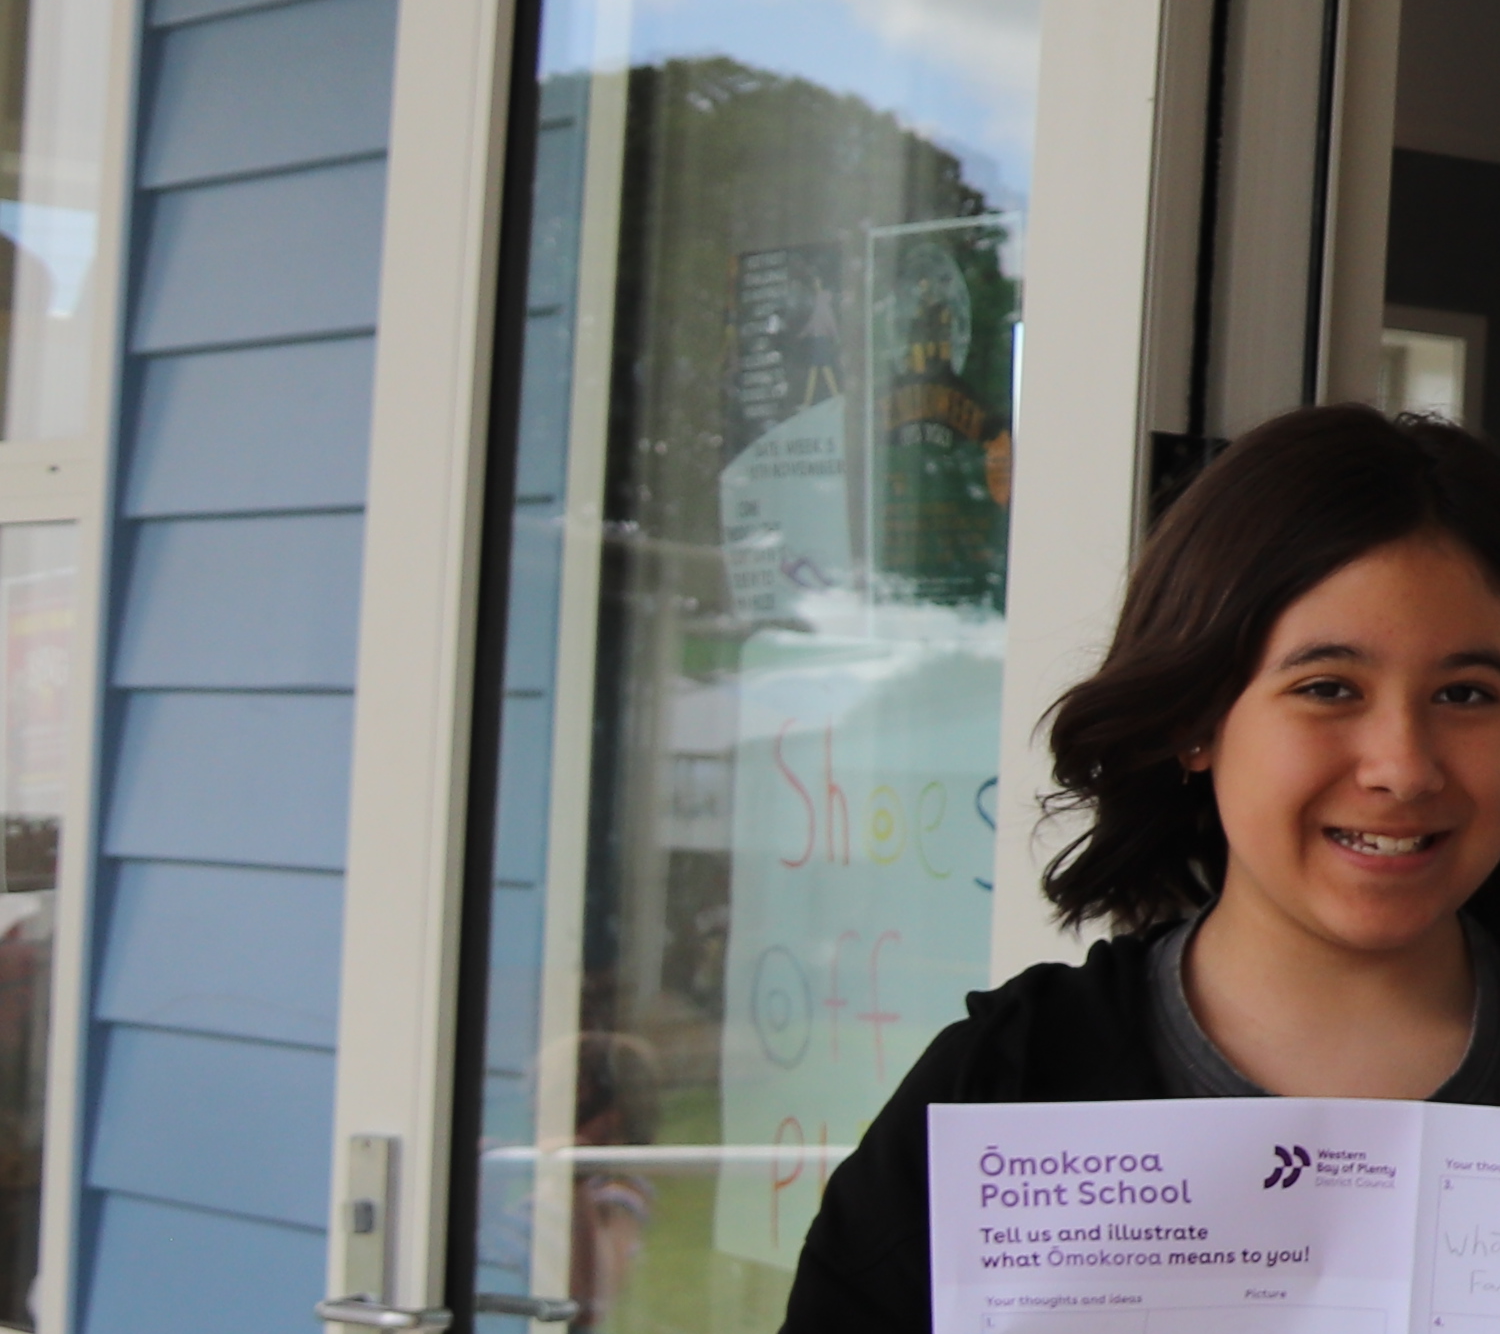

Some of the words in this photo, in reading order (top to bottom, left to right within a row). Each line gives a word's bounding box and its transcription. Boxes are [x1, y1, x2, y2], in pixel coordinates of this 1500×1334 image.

[980, 1145, 1162, 1176] Ōmokoroa
[1317, 1147, 1365, 1161] Western
[1316, 1161, 1338, 1175] Bay
[1342, 1163, 1354, 1174] of
[1358, 1164, 1396, 1177] Plenty
[1445, 1159, 1473, 1171] Your
[1315, 1176, 1352, 1188] District
[980, 1183, 1069, 1208] Point
[1078, 1178, 1191, 1205] School
[980, 1226, 1021, 1243] Tell
[1027, 1227, 1052, 1242] us
[1058, 1224, 1101, 1241] and
[1108, 1224, 1208, 1240] illustrate
[982, 1250, 1041, 1268] what
[1048, 1246, 1162, 1266] Ōmokoroa
[1169, 1249, 1236, 1264] means
[1242, 1248, 1261, 1263] to
[1267, 1246, 1310, 1267] you!
[985, 1295, 1015, 1307] Your
[1019, 1294, 1077, 1307] thoughts
[1082, 1294, 1106, 1304] and
[1110, 1294, 1142, 1304] ideas
[1244, 1288, 1287, 1299] Picture
[1434, 1316, 1445, 1327] 4.
